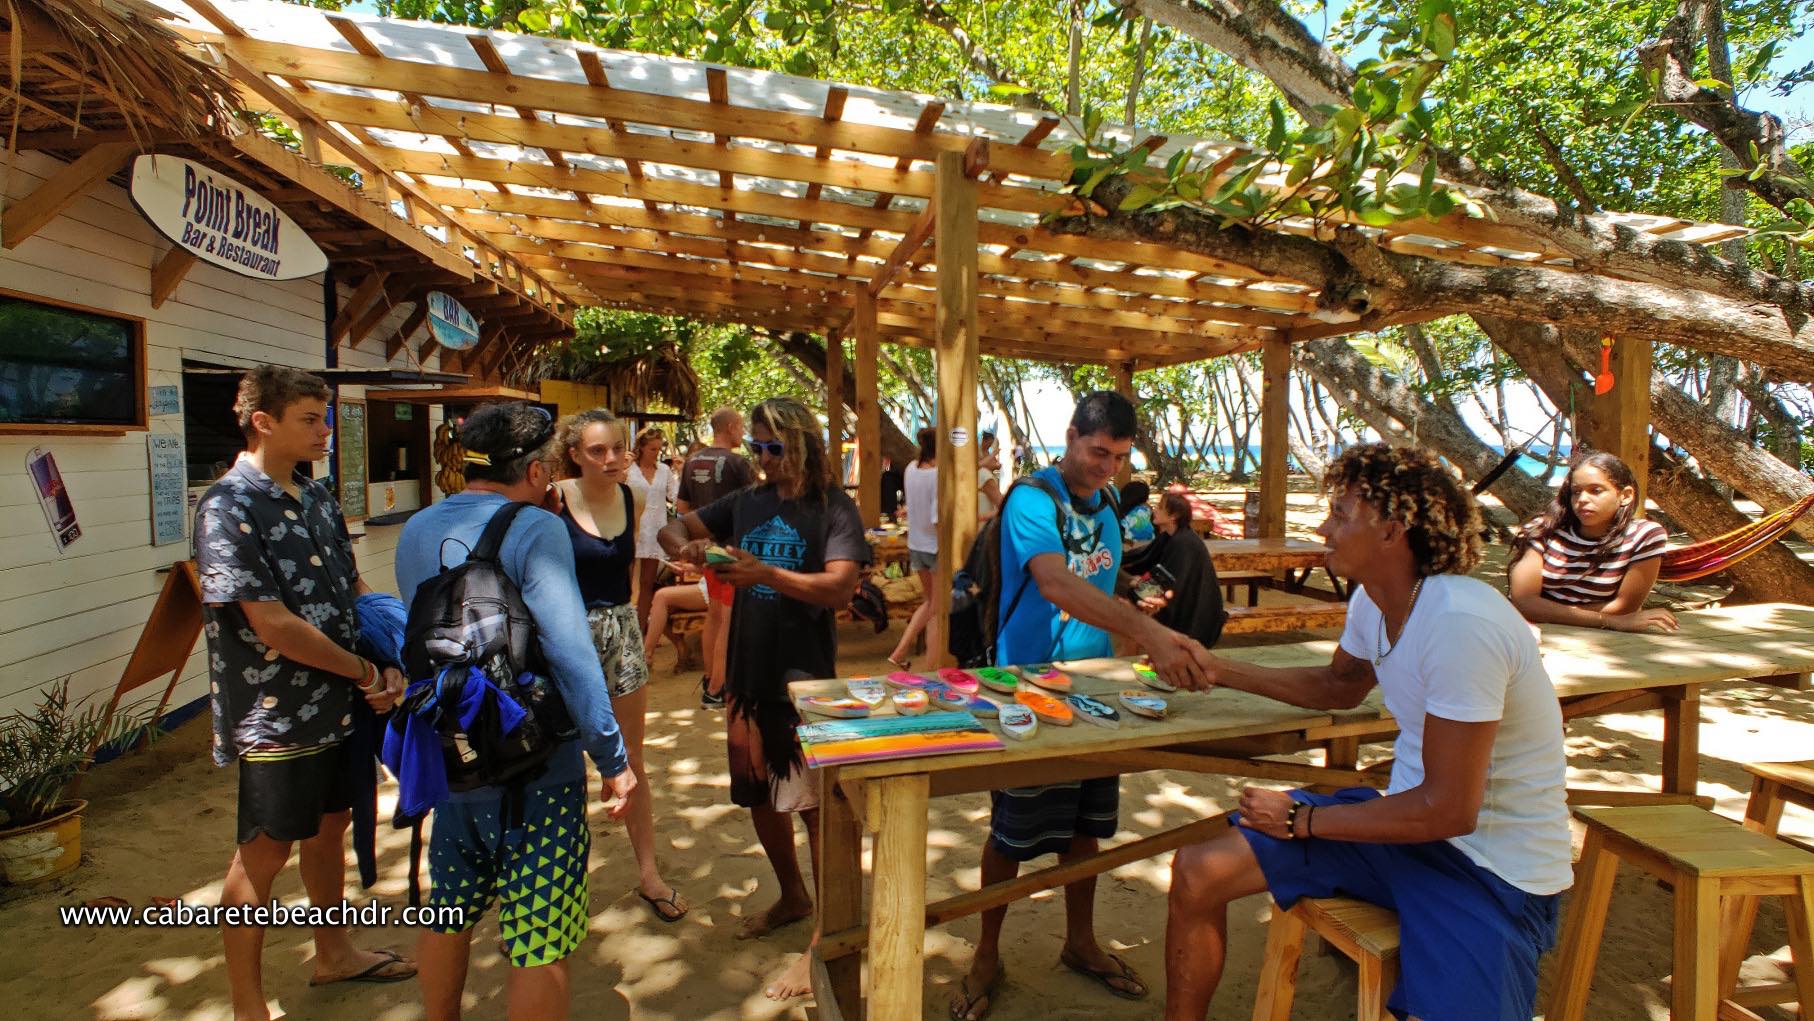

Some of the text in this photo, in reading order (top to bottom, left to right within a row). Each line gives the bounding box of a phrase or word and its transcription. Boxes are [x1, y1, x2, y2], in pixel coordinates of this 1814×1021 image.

[182, 163, 281, 255] Point Break
[181, 221, 281, 277] Bar & Restaurant
[443, 294, 460, 327] BAR
